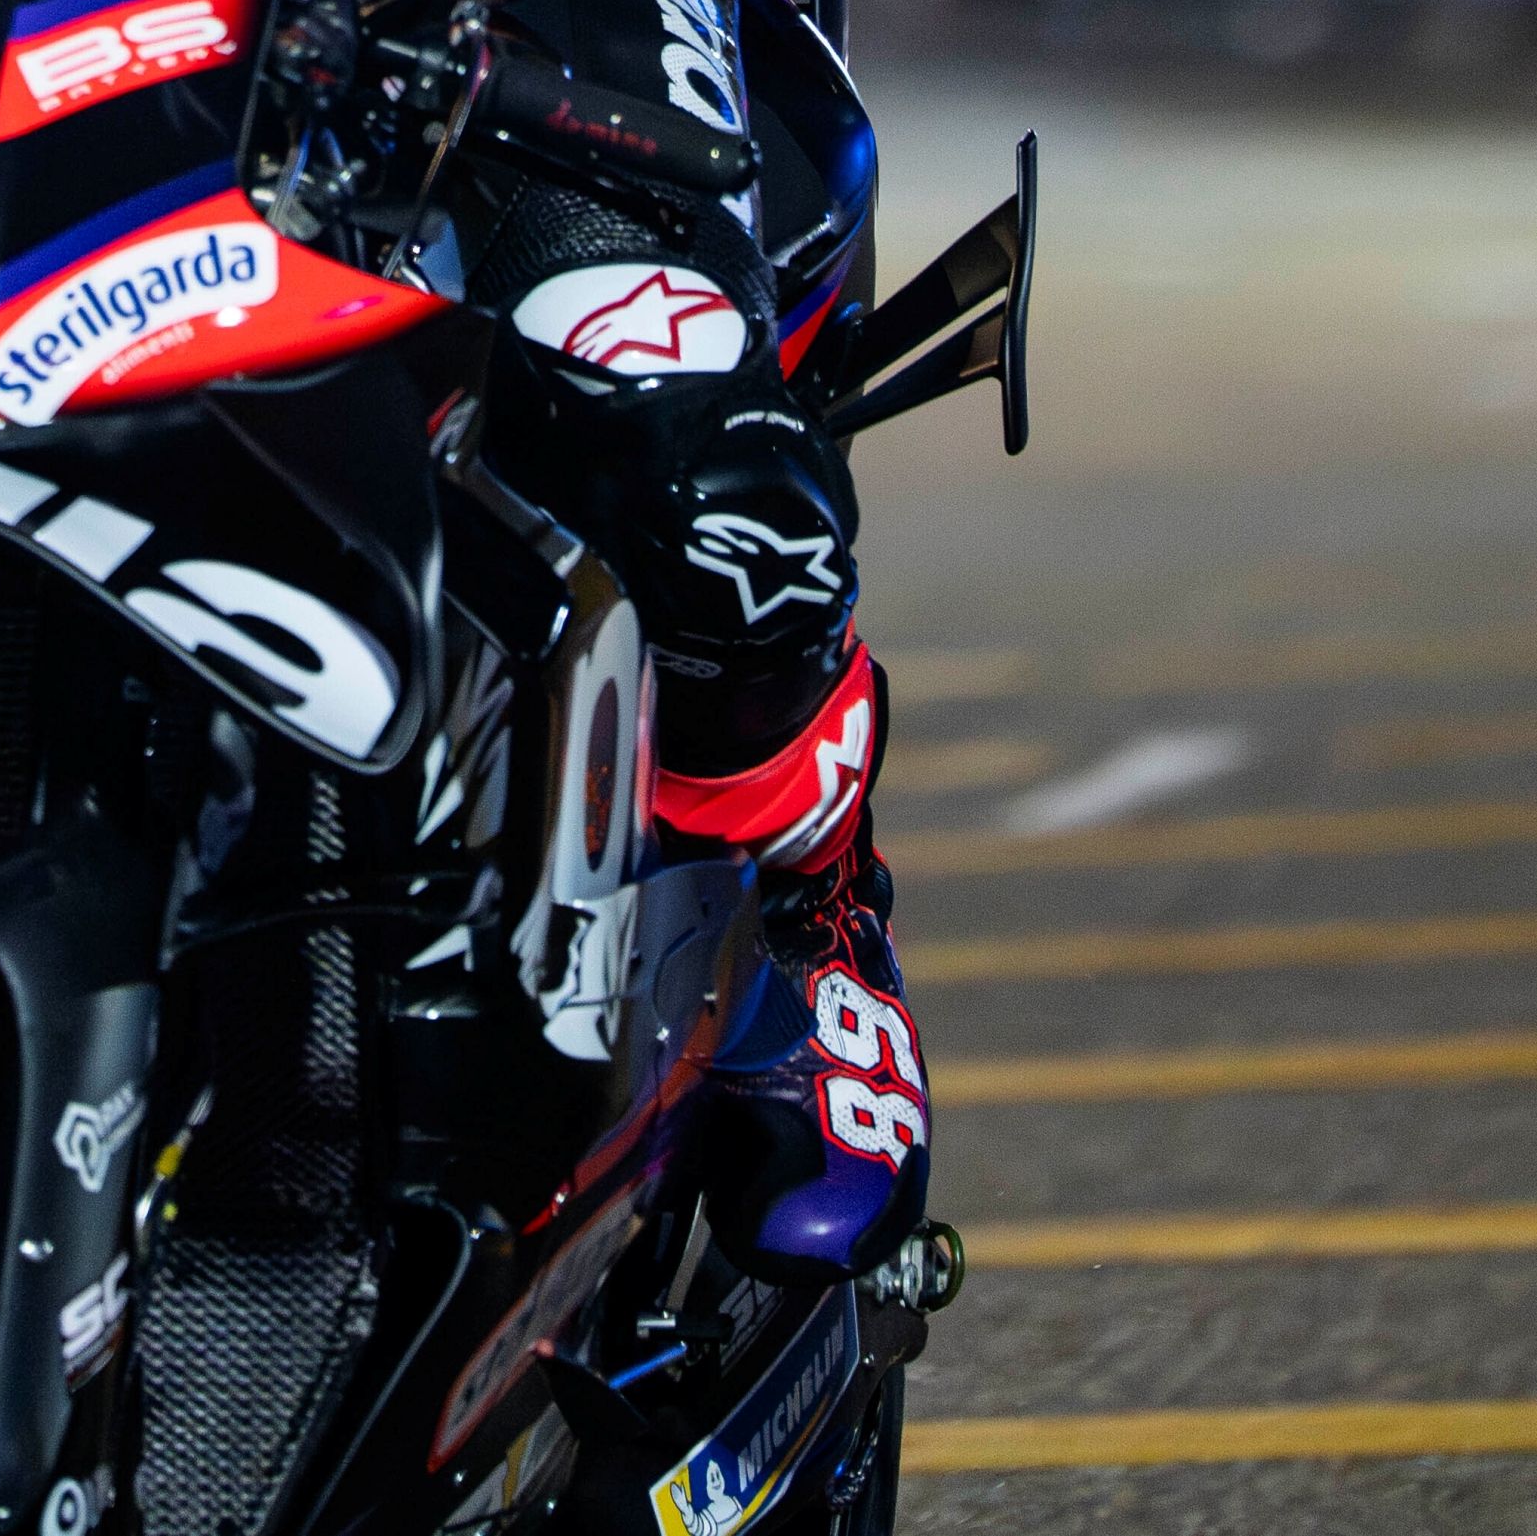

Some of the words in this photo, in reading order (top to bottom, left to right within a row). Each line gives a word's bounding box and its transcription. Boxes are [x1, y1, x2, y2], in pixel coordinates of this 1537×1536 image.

[15, 0, 229, 103] BS
[814, 965, 927, 1170] 89
[737, 1313, 845, 1493] MICHELIN
